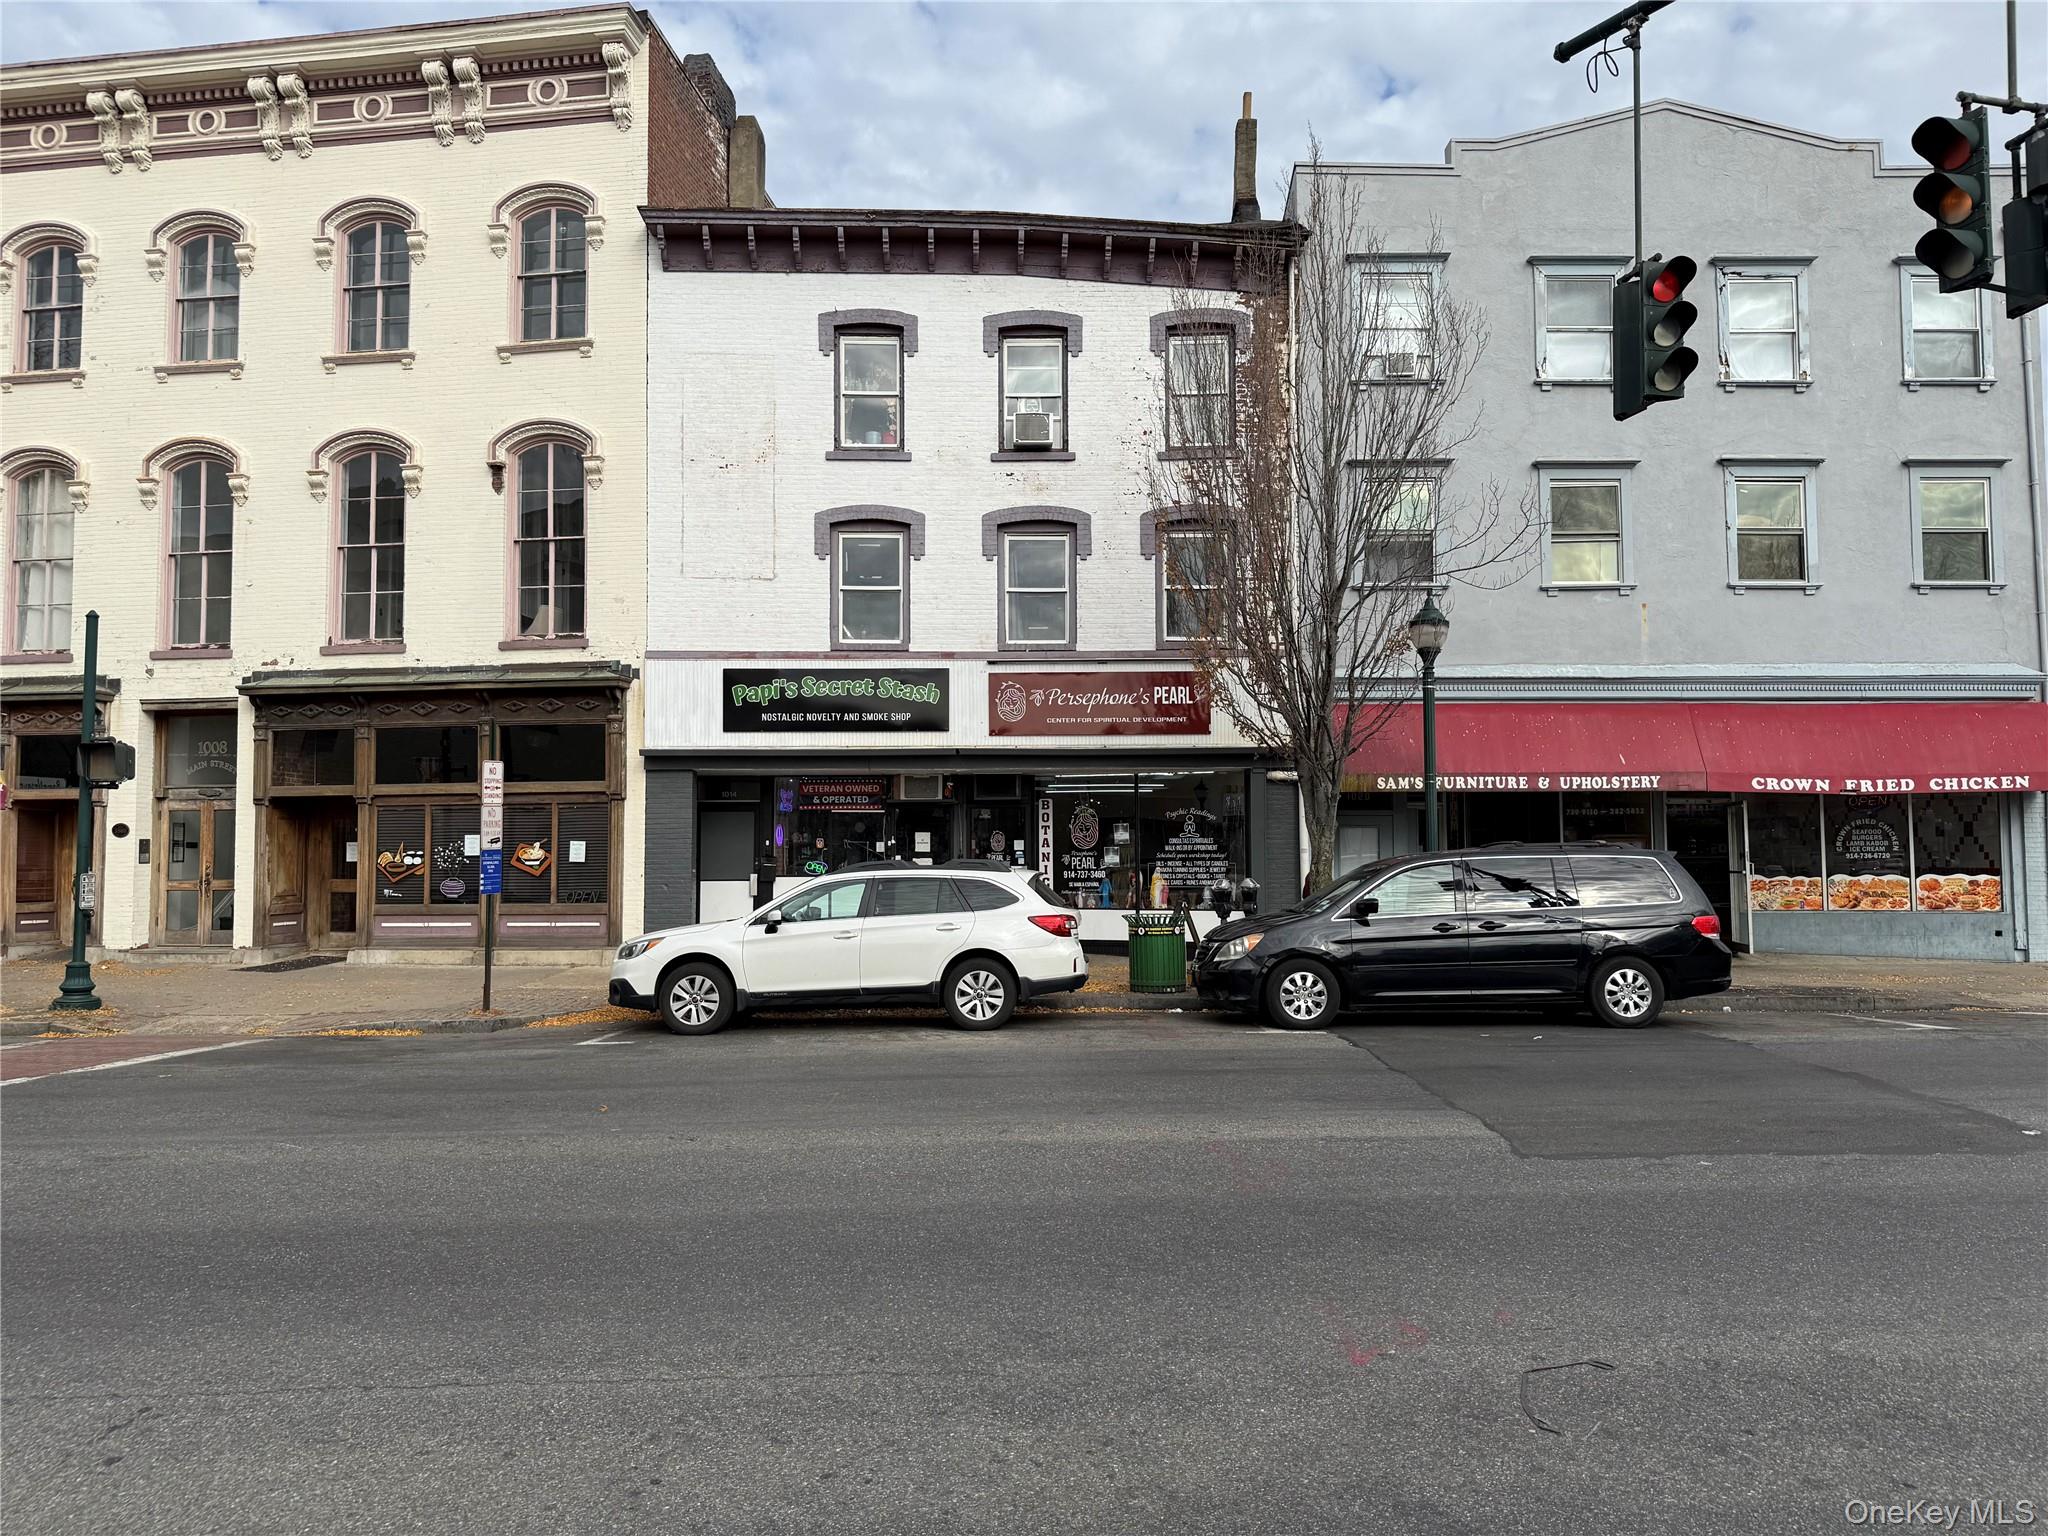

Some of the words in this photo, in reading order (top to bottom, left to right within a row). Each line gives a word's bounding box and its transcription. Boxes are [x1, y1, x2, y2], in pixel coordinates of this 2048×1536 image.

[731, 678, 798, 706] Papi's
[800, 676, 875, 698] Secret
[876, 677, 940, 704] Stash
[1045, 687, 1150, 714] Persephone's
[1154, 686, 1193, 705] PEARL
[761, 712, 804, 722] NOSTALGIC
[806, 712, 841, 722] NOVELTY
[843, 712, 860, 721] AND
[862, 712, 889, 721] SMOKE
[891, 712, 911, 721] SHOP
[198, 741, 228, 754] 1008
[185, 760, 208, 776] MAIN
[489, 767, 496, 776] NO
[802, 784, 843, 793] VETERAN
[844, 784, 880, 793] OWNED
[1376, 776, 1424, 790] SAM'S
[1435, 776, 1529, 789] FURNITURE
[1538, 776, 1550, 788] &
[1560, 775, 1661, 790] UPHOLSTERY
[1751, 777, 1830, 791] CROWN
[1845, 778, 1915, 792] FRIED
[1929, 775, 2030, 790] CHICKEN
[813, 796, 820, 804] &
[822, 795, 869, 804] OPERATED
[488, 809, 496, 818] NO
[1165, 808, 1188, 819] Psychic
[1189, 807, 1217, 821] Readings
[1835, 824, 1851, 852] CROWN
[1878, 821, 1900, 851] CHICKEN
[806, 861, 827, 874] OPEN
[1071, 857, 1097, 869] PEARL
[1063, 870, 1106, 879] 914-737-3460
